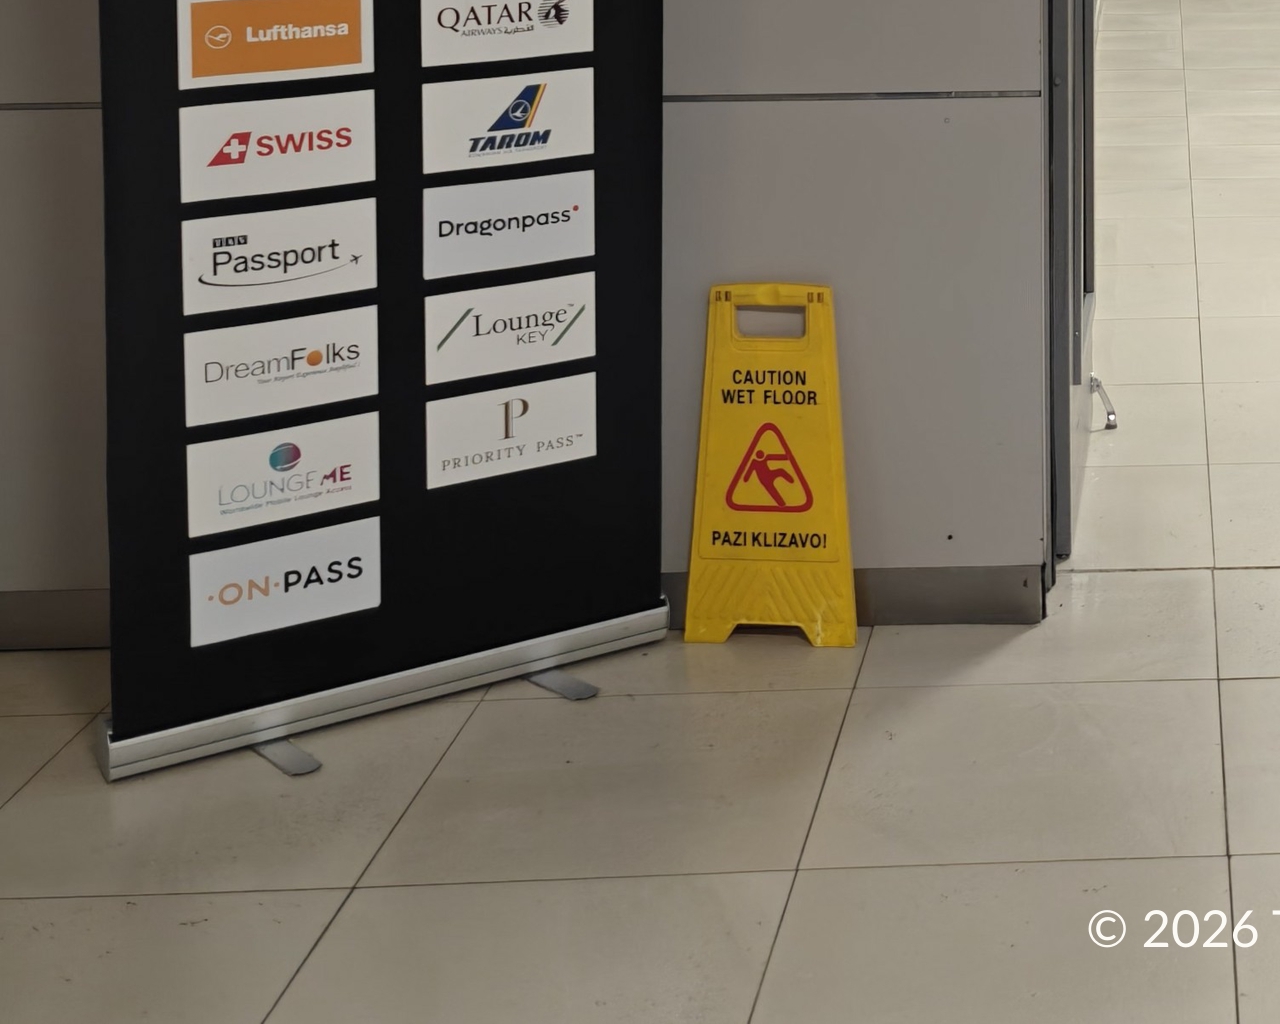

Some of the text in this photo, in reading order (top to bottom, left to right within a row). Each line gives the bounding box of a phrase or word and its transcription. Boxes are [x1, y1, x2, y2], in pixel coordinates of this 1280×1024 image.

[437, 1, 533, 33] QATAR
[246, 23, 349, 43] Lufthansa
[461, 27, 503, 37] AIRWAYS
[256, 127, 352, 156] SWISS
[469, 129, 552, 153] TAROM
[438, 209, 571, 238] Dragonpass
[213, 239, 340, 276] Passport
[517, 330, 548, 345] KEY
[204, 342, 361, 383] DreamFolks
[732, 369, 806, 386] CAUTION
[721, 389, 818, 405] WET FLOOR
[441, 444, 526, 471] PRIORITY
[712, 530, 827, 549] PAZI KLIZAVO!
